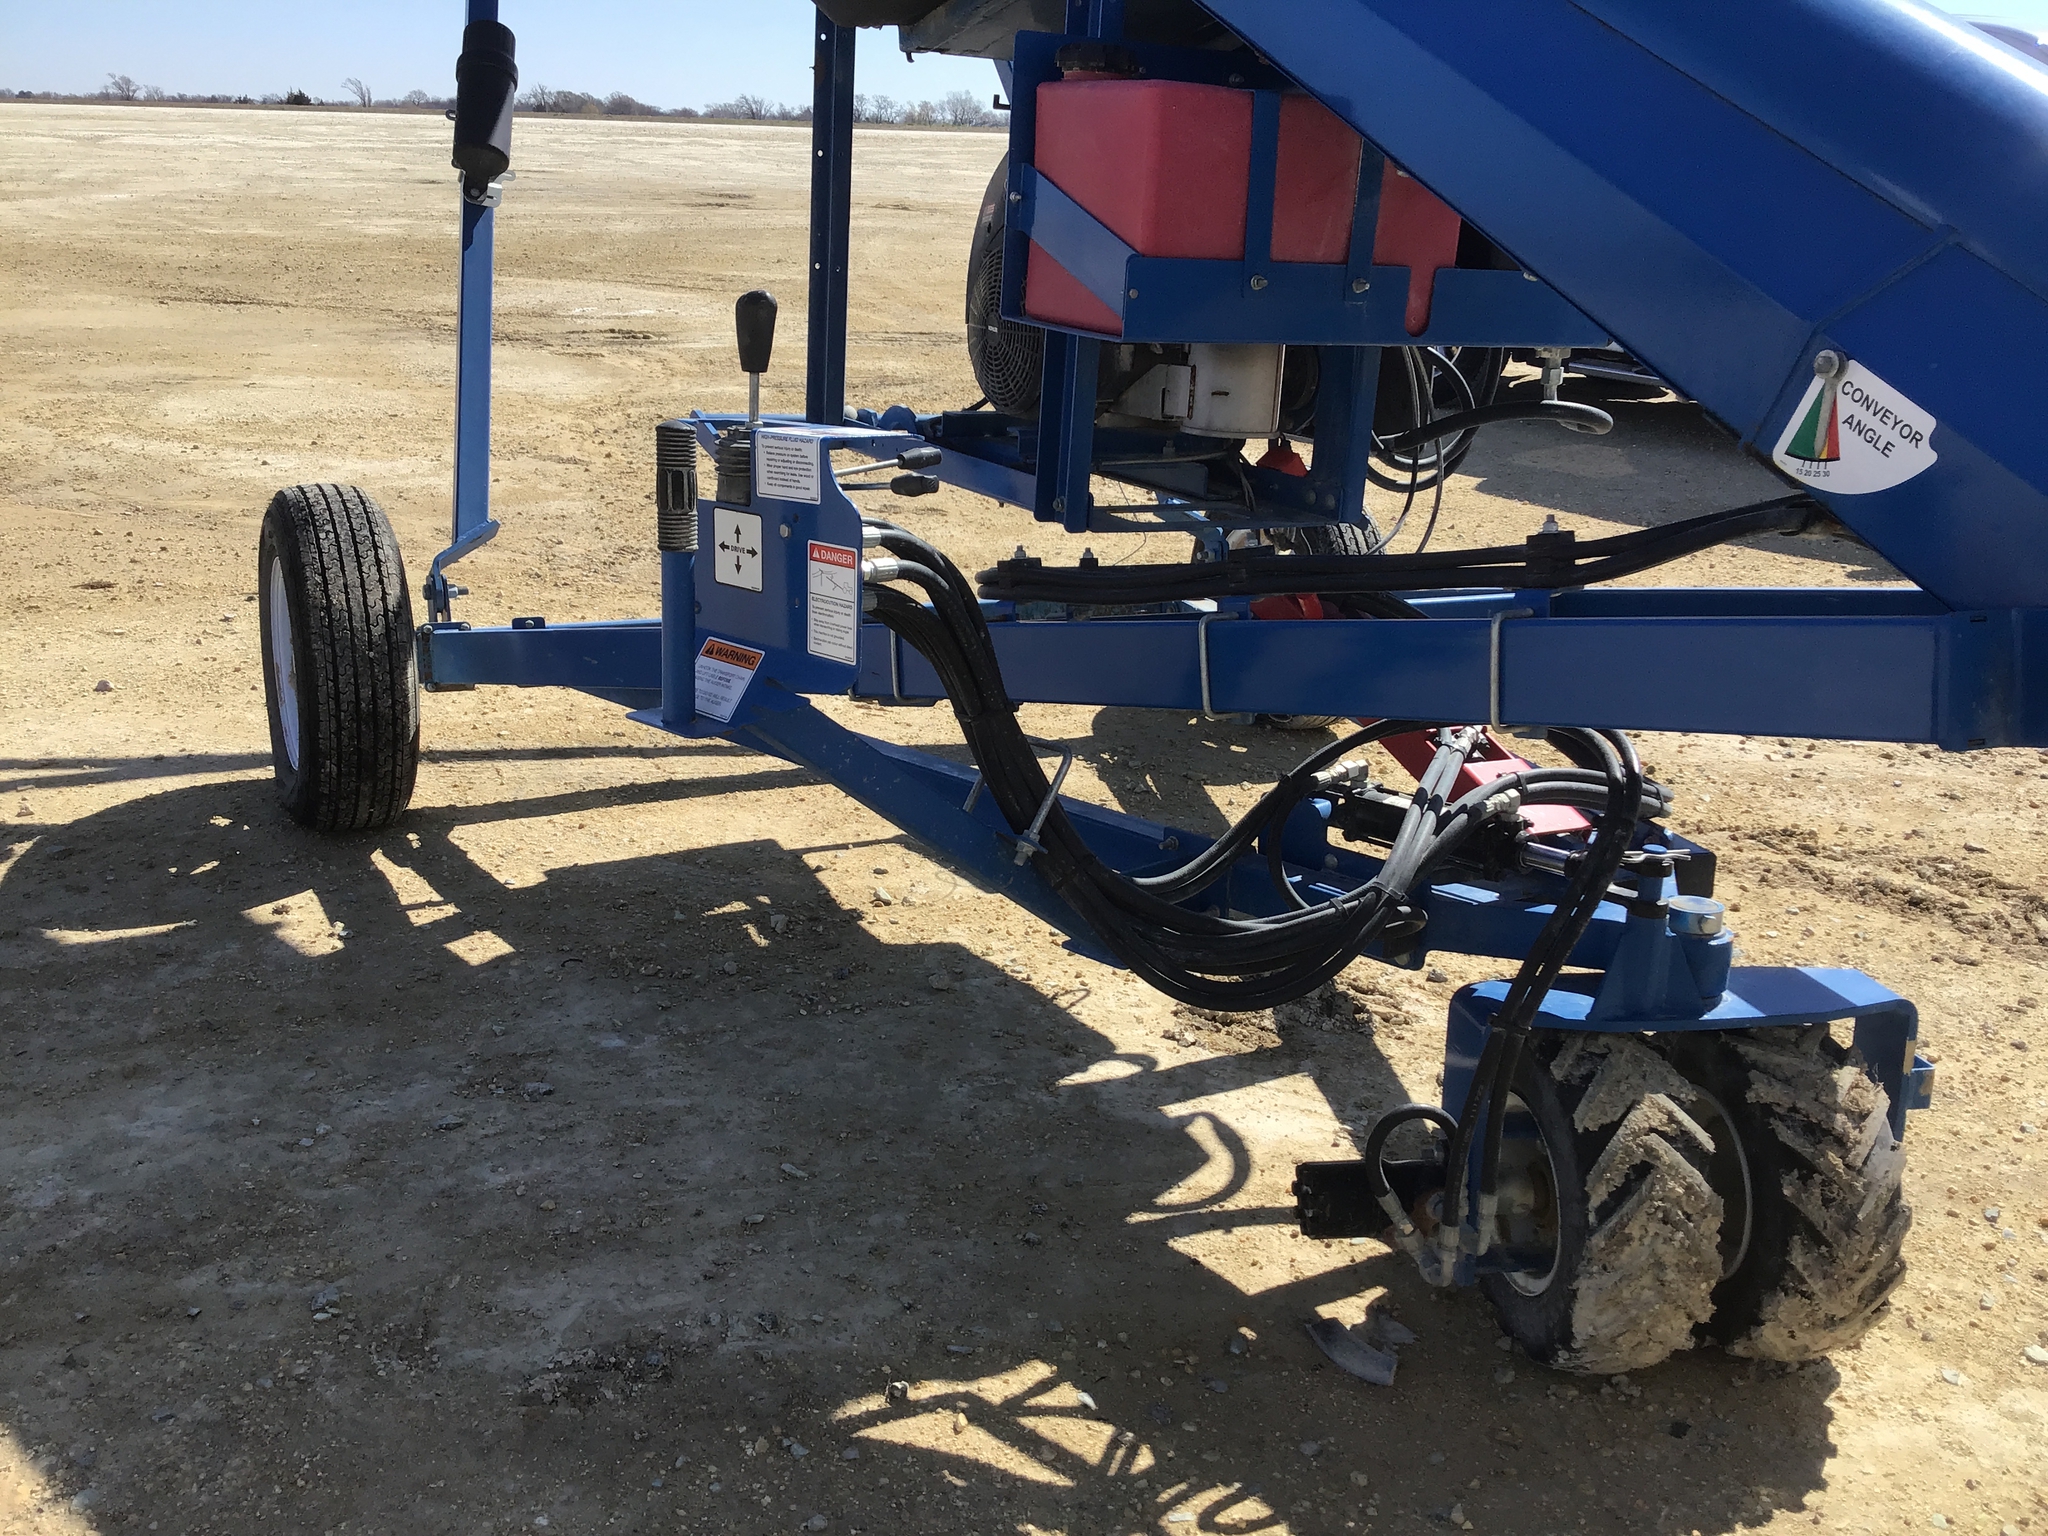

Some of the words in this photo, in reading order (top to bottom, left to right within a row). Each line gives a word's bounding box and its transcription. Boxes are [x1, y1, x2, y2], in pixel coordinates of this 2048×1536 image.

[1842, 380, 1924, 449] CONVEYOR
[1842, 413, 1896, 459] ANGLE
[1804, 469, 1812, 477] 20
[1813, 470, 1821, 478] 25
[1822, 470, 1831, 478] 30
[731, 545, 745, 554] DRIVE
[820, 549, 853, 565] DANGER
[715, 646, 757, 666] WARNING
